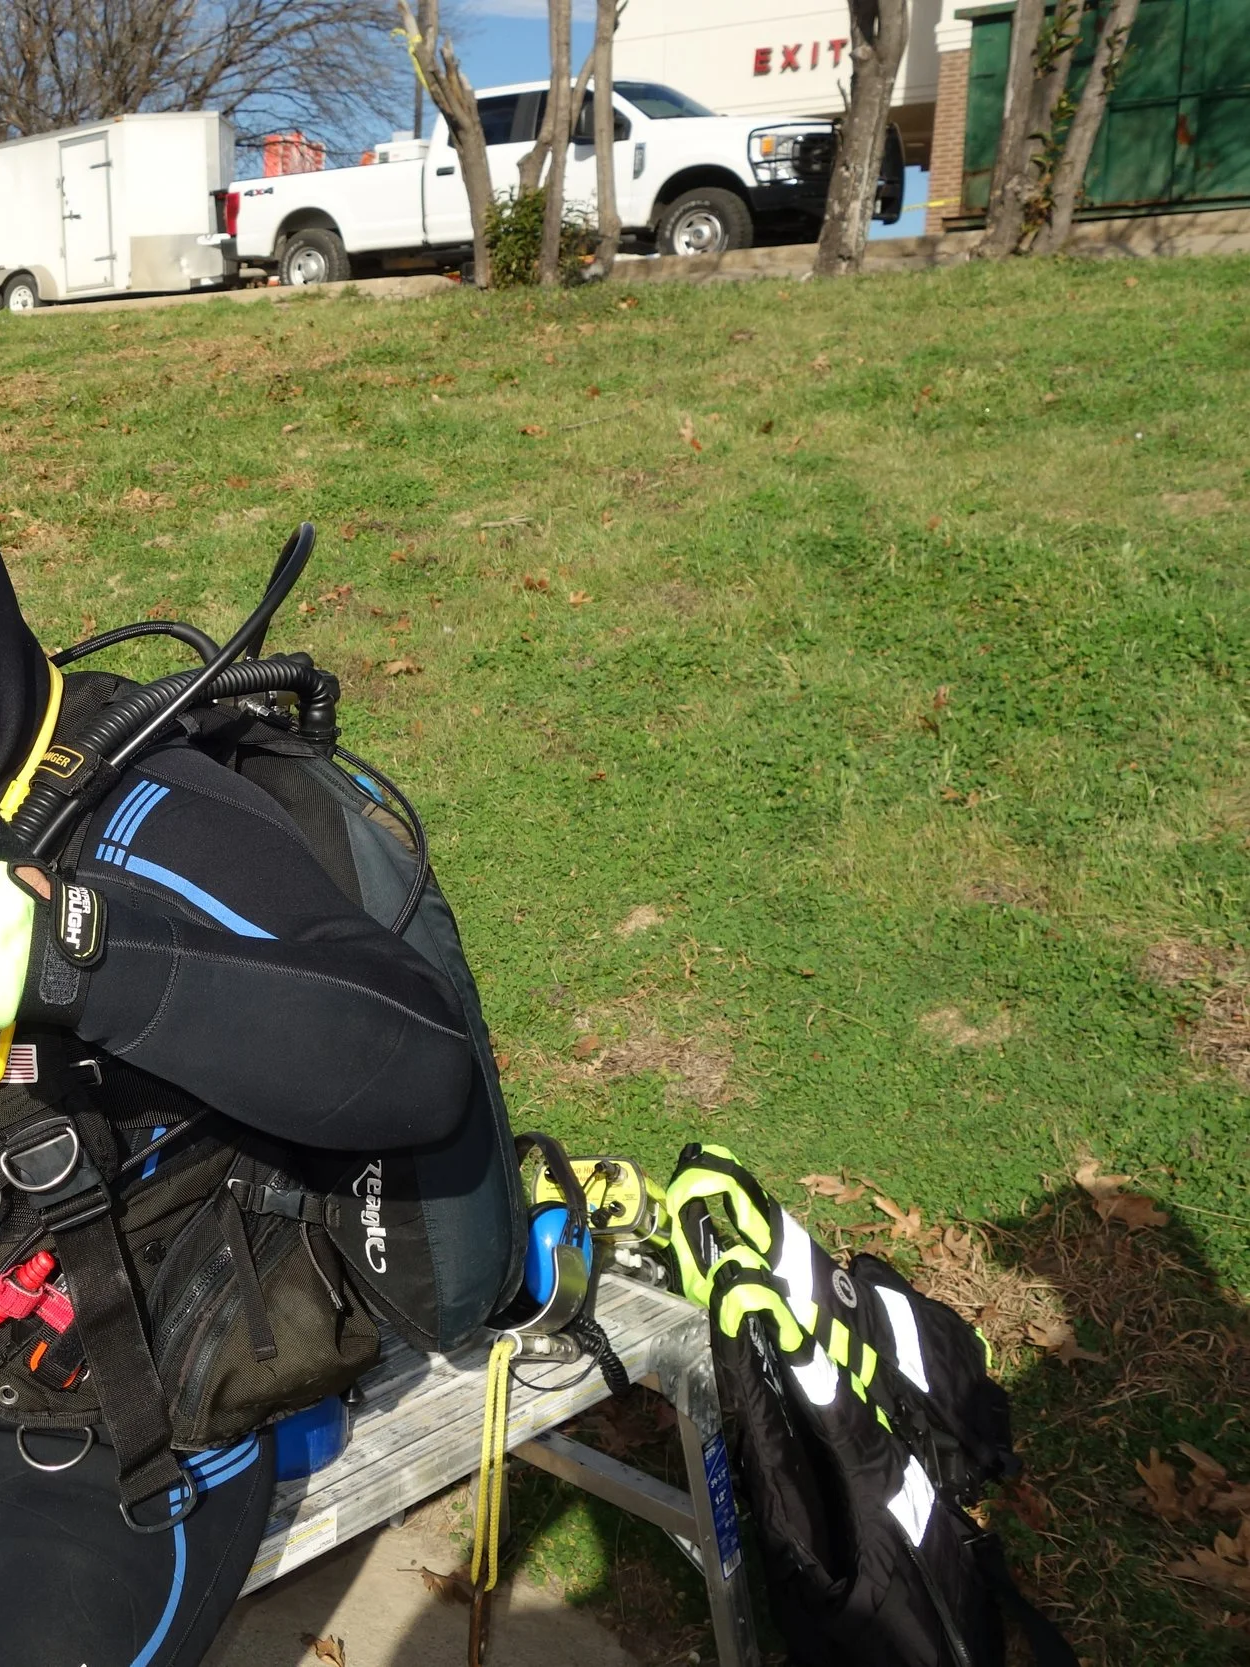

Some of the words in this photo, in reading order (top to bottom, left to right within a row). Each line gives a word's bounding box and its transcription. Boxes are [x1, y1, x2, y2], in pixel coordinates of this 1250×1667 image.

[753, 39, 848, 77] EXIT
[43, 751, 71, 768] NGER
[66, 885, 83, 945] TOUGH
[79, 887, 91, 914] HYPER
